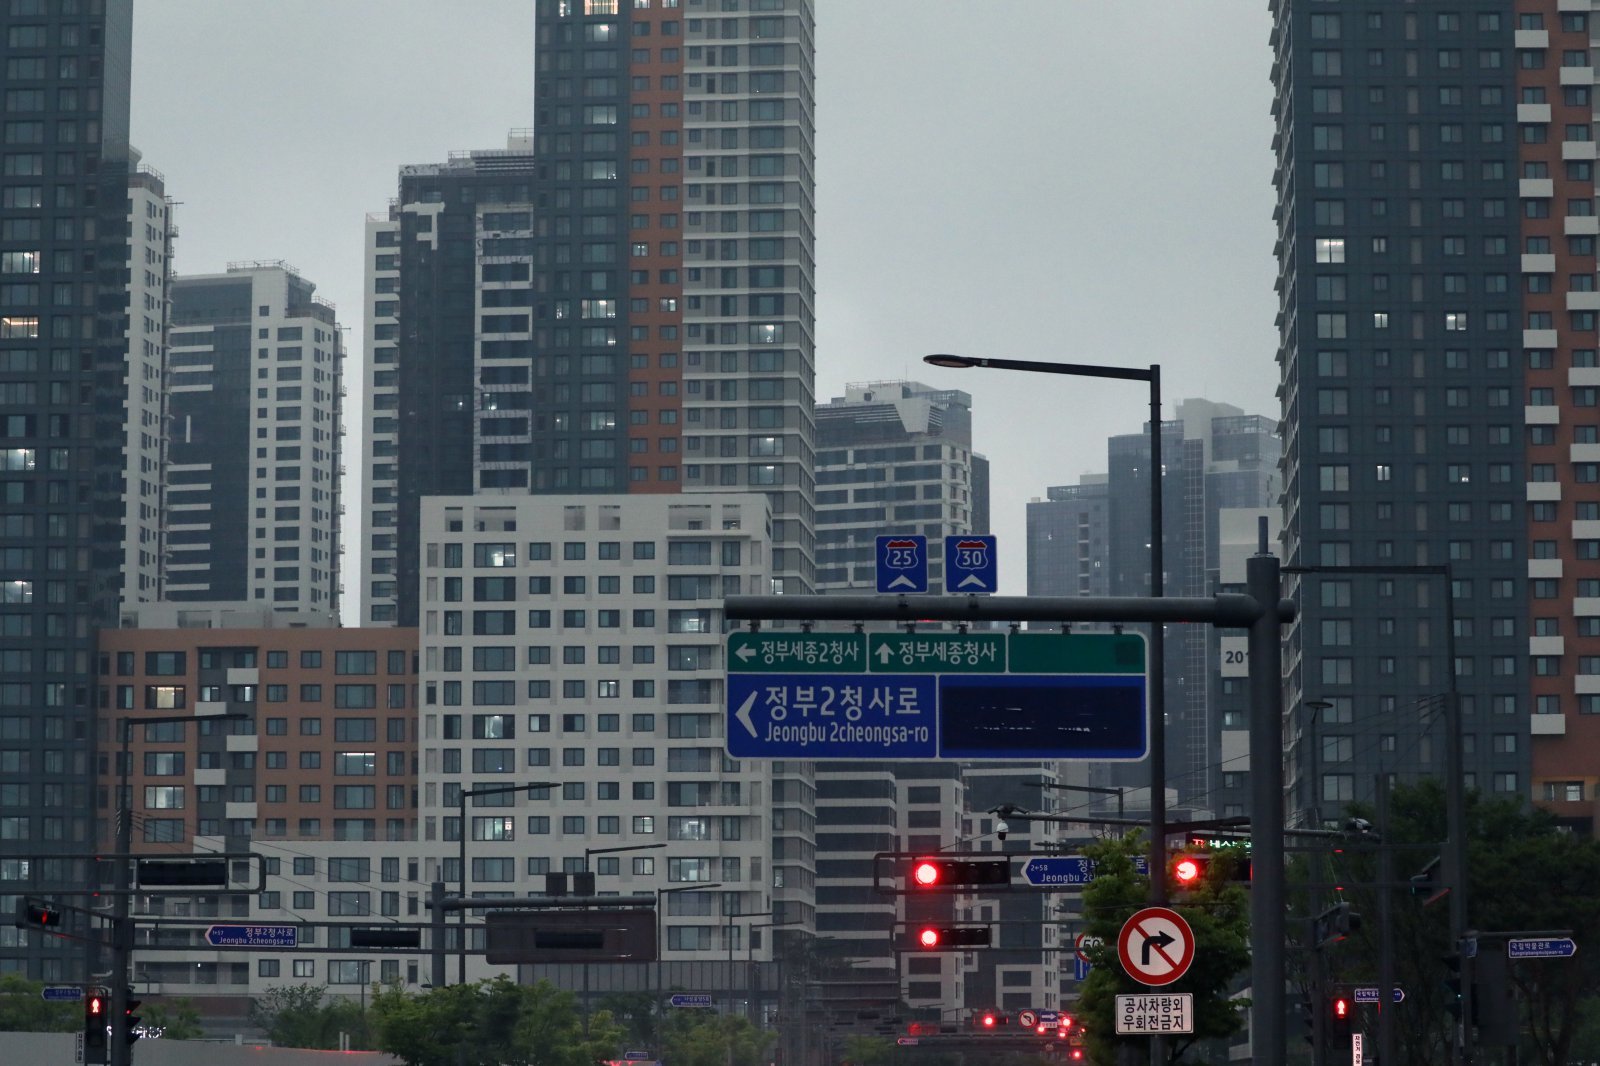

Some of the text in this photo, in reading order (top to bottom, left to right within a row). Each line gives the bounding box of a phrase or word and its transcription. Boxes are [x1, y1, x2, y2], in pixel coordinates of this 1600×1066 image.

[892, 550, 912, 566] 25
[962, 550, 982, 566] 30
[761, 640, 859, 665] 정부세종2청사
[898, 640, 997, 665] 정부세종청사
[765, 685, 921, 721] 정부2청사로
[765, 721, 929, 747] Jeongbu 2cheongsa-ro
[1041, 873, 1080, 884] Jeongbu
[219, 937, 247, 945] Jeongbu
[245, 927, 294, 938] 정부2청사로
[1124, 996, 1183, 1014] 공사차량외
[1123, 1014, 1184, 1031] 우회전금지
